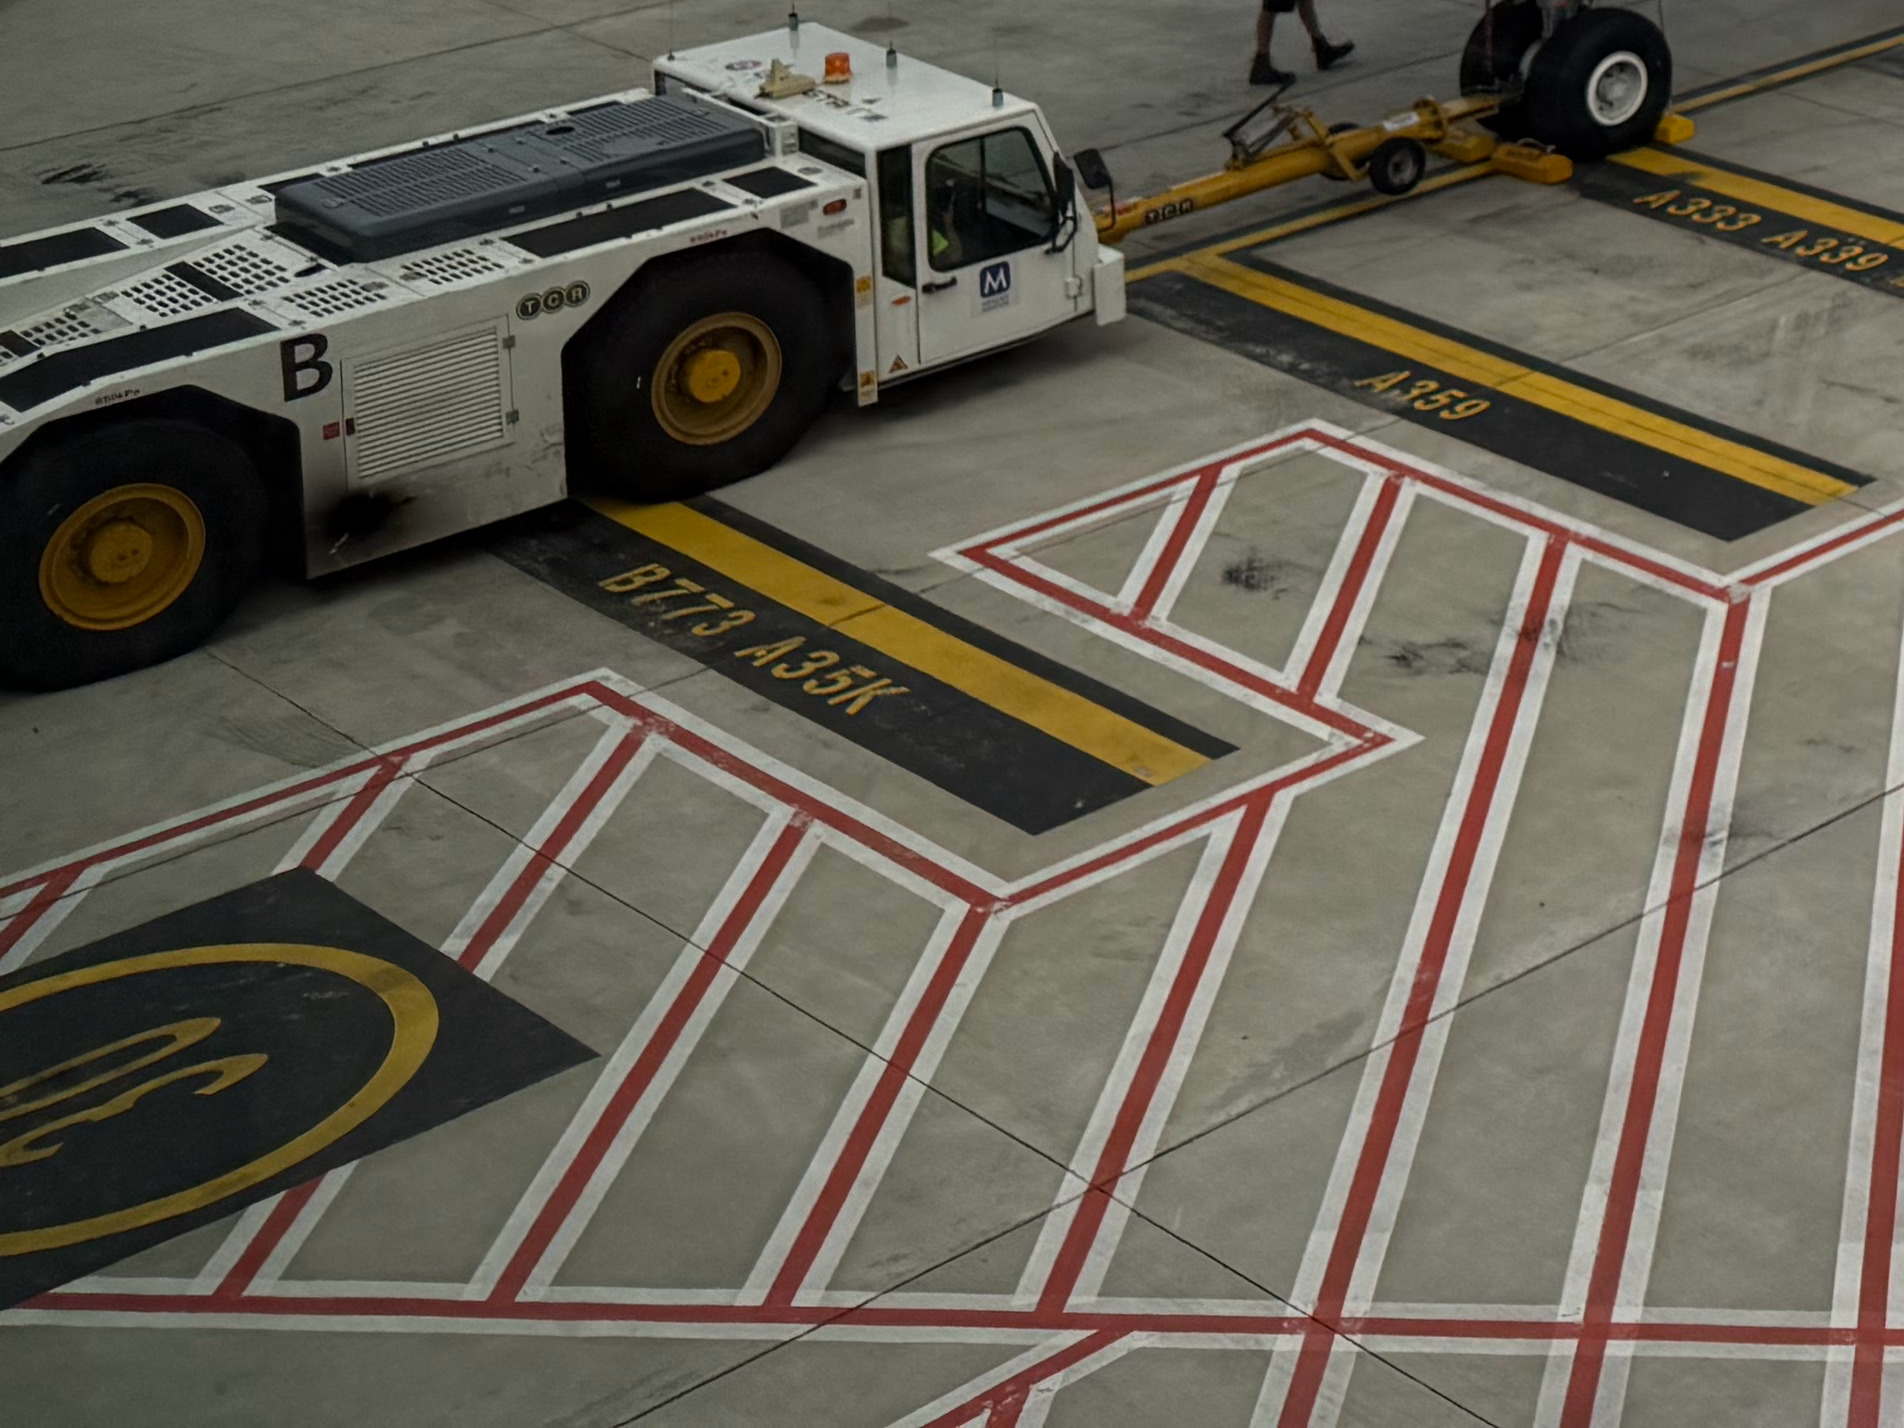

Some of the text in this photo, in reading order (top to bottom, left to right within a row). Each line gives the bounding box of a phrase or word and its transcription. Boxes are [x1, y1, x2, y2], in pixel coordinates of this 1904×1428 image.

[1633, 189, 1762, 231] A333
[1760, 229, 1889, 272] A339
[280, 333, 334, 403] B
[1353, 370, 1491, 421] A359
[598, 562, 912, 716] B773 A35K
